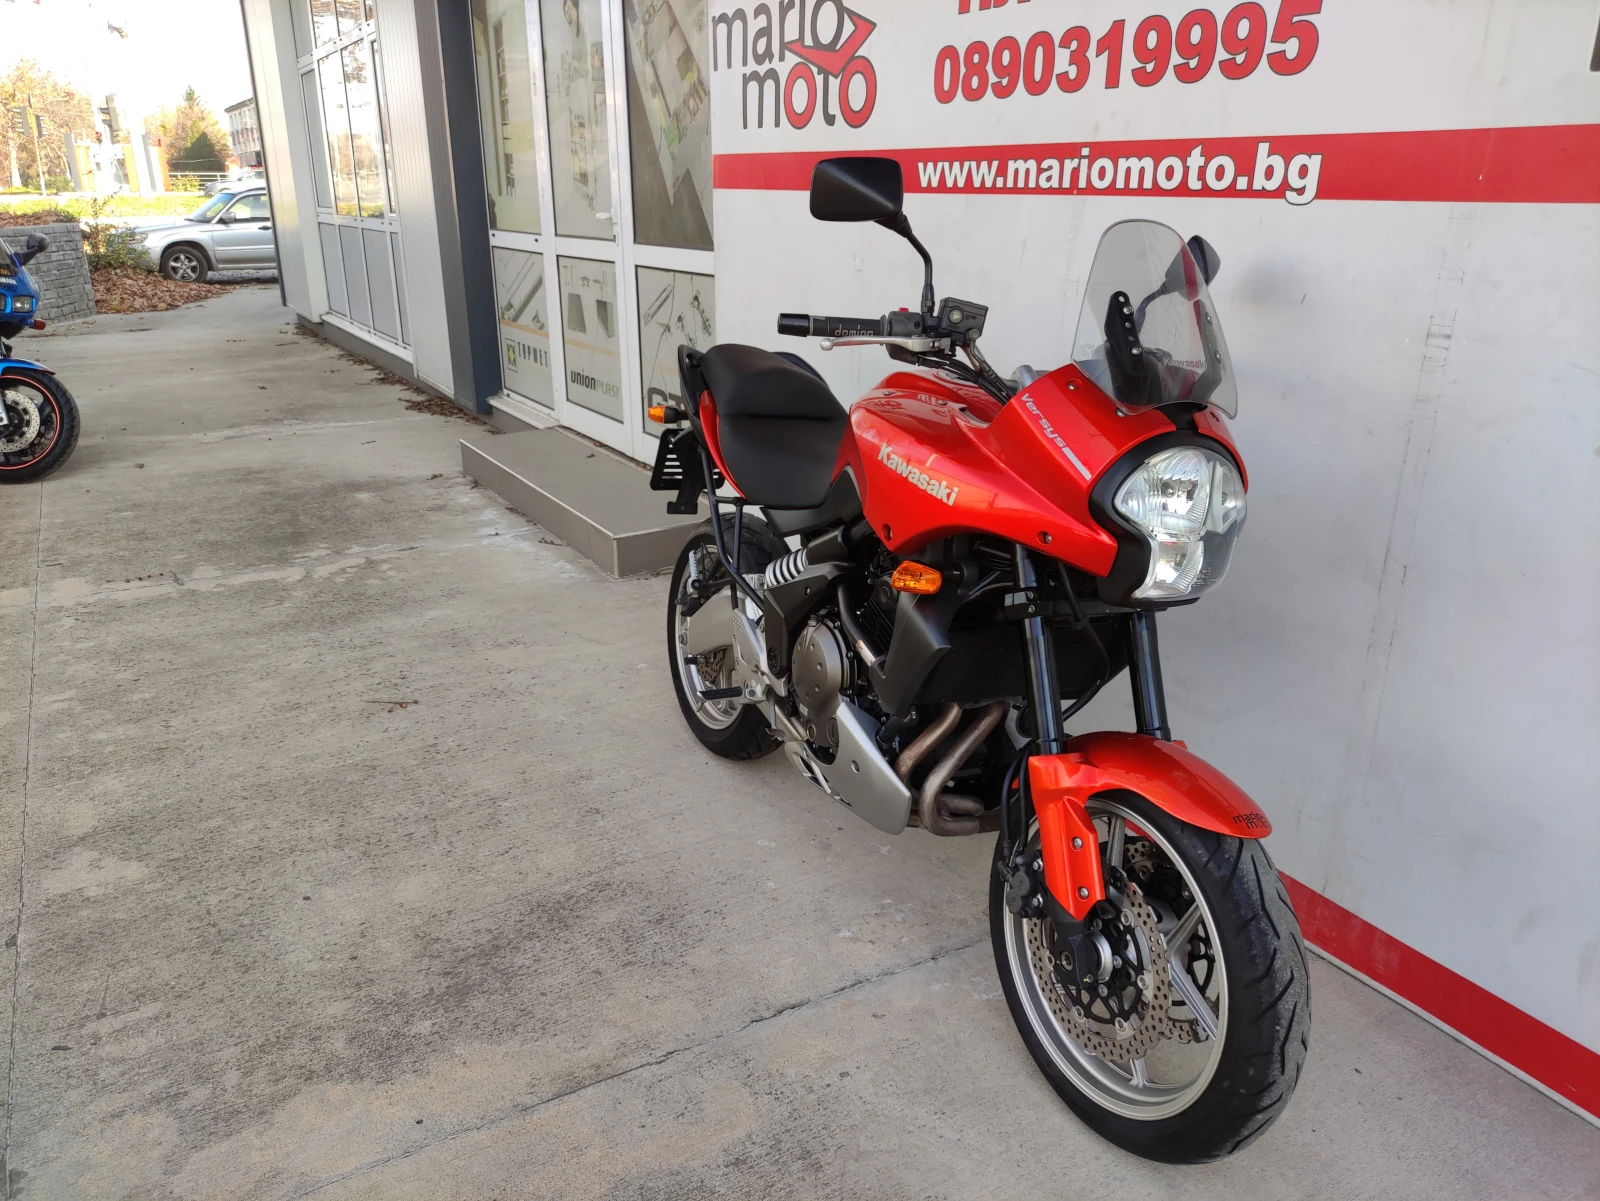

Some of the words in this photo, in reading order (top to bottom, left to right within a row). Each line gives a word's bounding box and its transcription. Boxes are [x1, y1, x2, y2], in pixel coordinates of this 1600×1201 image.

[712, 0, 846, 71] mario
[934, 0, 1323, 104] 0890319995
[742, 55, 877, 130] moto
[918, 142, 1322, 205] www.mariomoto.bg
[834, 323, 874, 336] domino
[877, 442, 959, 507] Kawasaki
